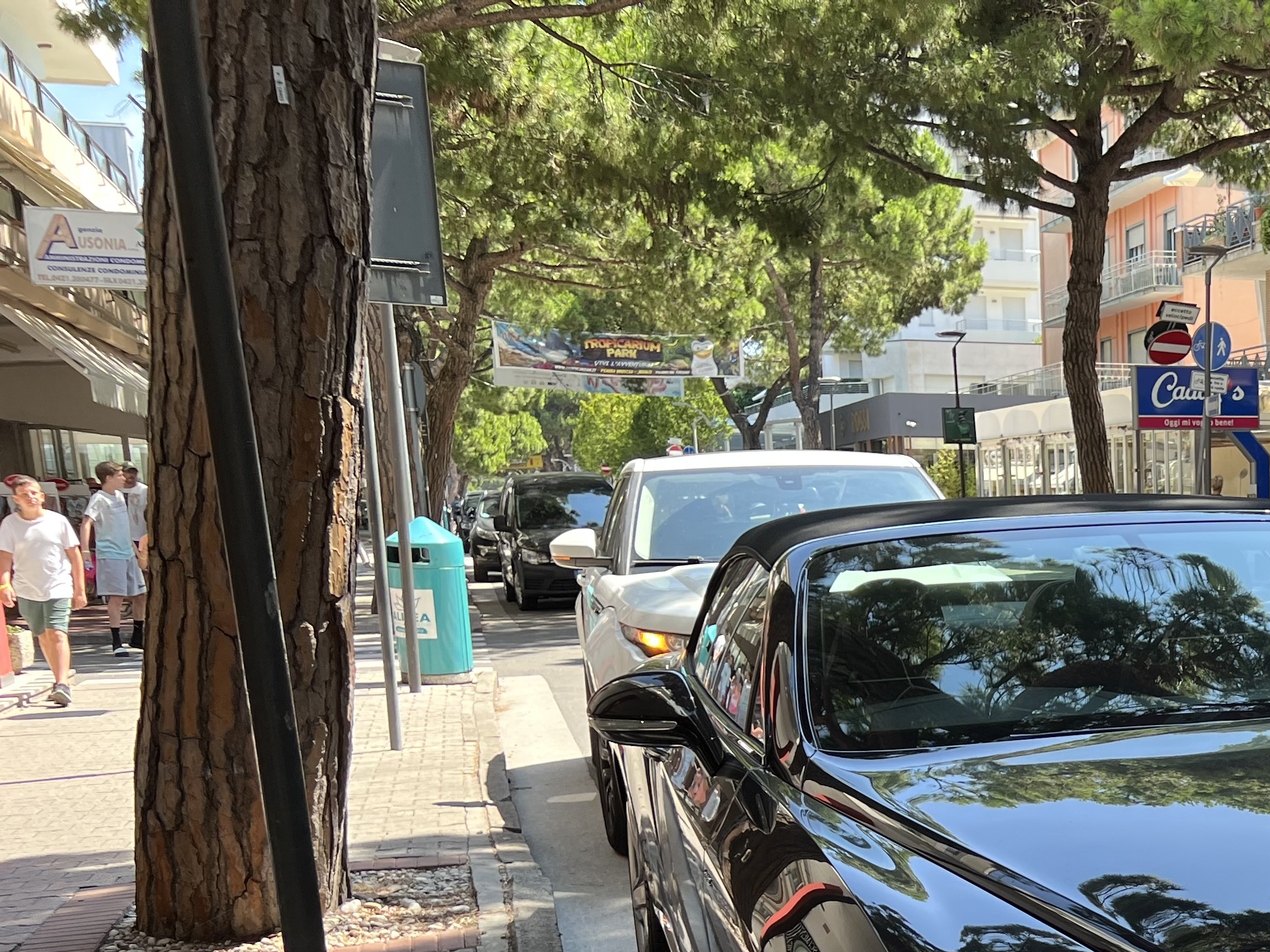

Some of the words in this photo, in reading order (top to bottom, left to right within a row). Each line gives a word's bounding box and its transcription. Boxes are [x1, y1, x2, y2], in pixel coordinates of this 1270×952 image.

[47, 265, 96, 273] CONSULENZE
[1165, 313, 1194, 321] velocipedi
[584, 338, 662, 352] TROPICARIUM
[606, 349, 637, 359] PARK
[1164, 419, 1180, 427] Oggi
